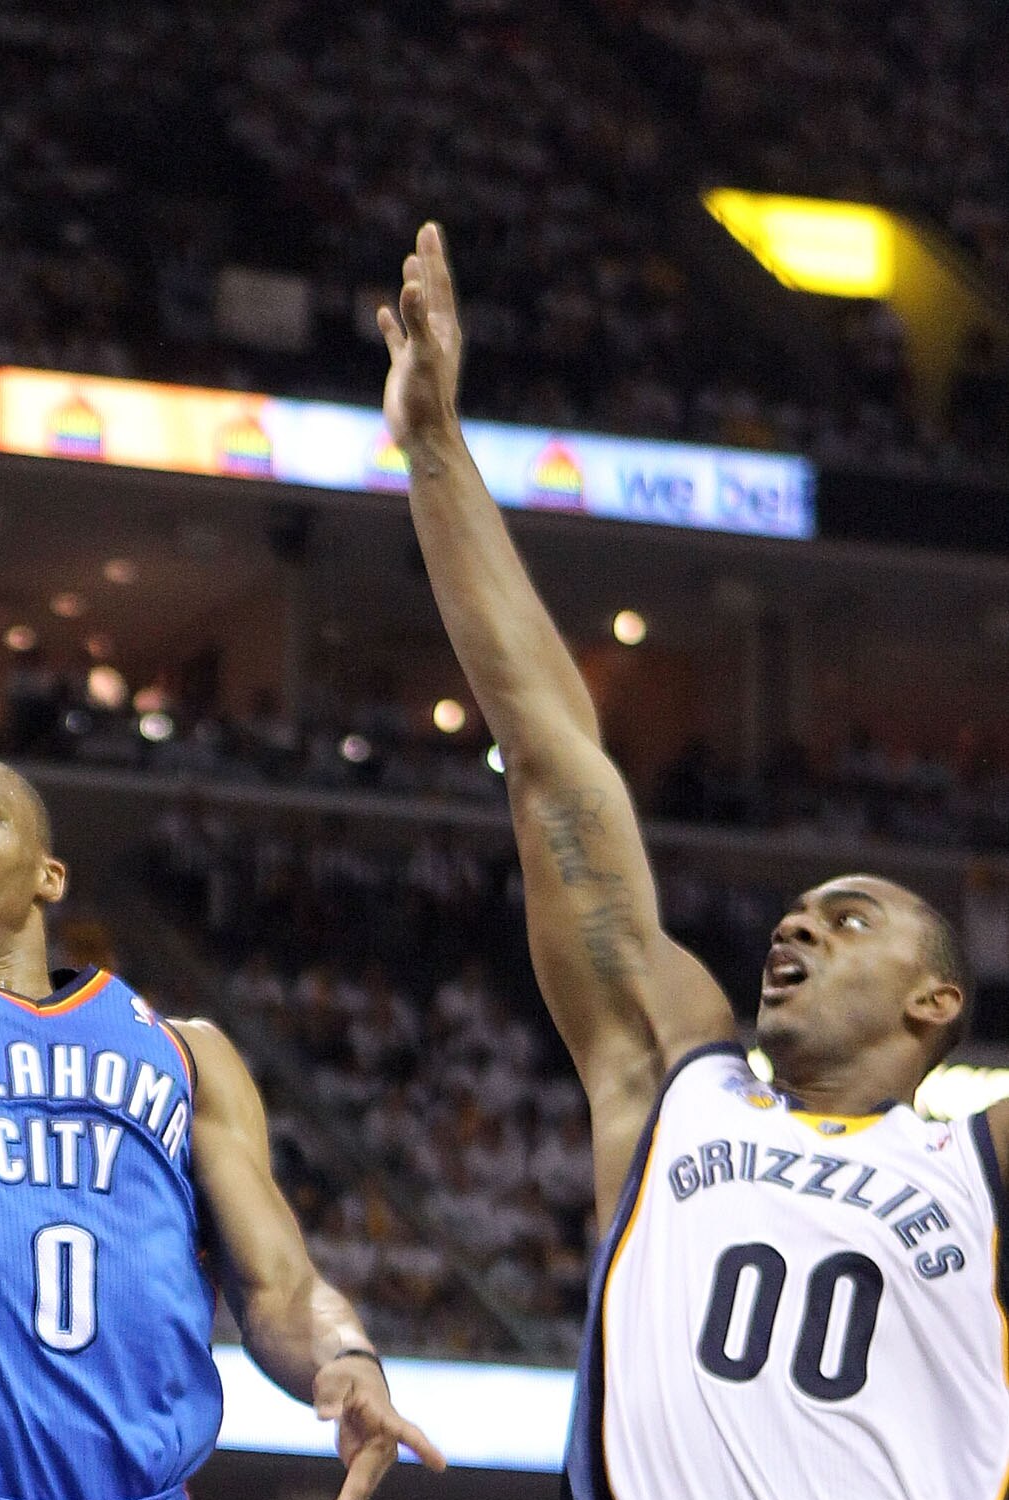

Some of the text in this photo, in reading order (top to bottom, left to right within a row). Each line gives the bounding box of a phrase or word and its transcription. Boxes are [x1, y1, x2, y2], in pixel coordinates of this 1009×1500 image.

[667, 1138, 966, 1281] GRIZZLIES
[32, 1221, 100, 1353] 0
[695, 1240, 885, 1404] 00
